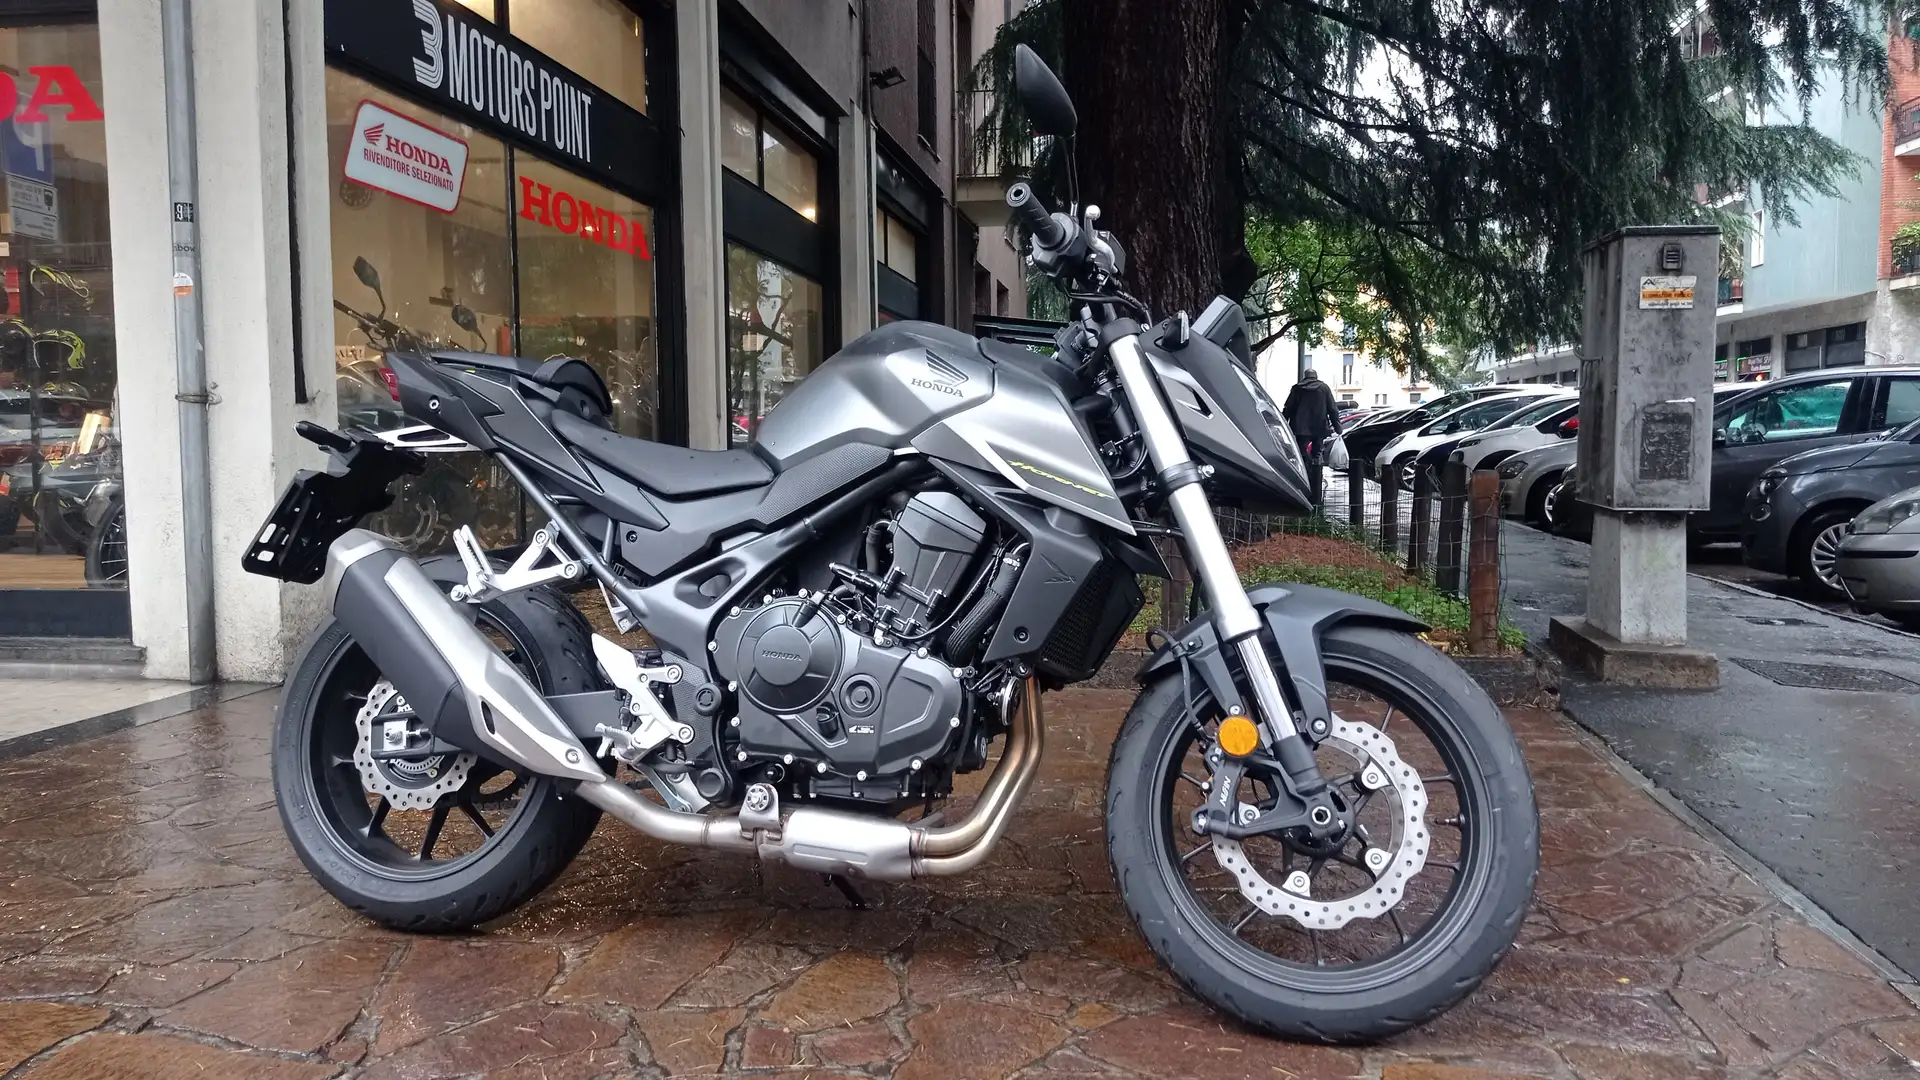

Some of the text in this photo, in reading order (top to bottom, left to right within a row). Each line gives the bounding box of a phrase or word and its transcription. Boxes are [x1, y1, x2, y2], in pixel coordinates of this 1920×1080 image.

[412, 0, 592, 163] 3 MOTORS POINT
[363, 148, 454, 193] RIVENDITORE SELEZIONATO
[385, 134, 453, 176] HONDA
[519, 175, 651, 261] HONDA
[910, 377, 965, 399] HONDA
[1008, 459, 1116, 500] HORNET
[761, 649, 803, 662] HONDA
